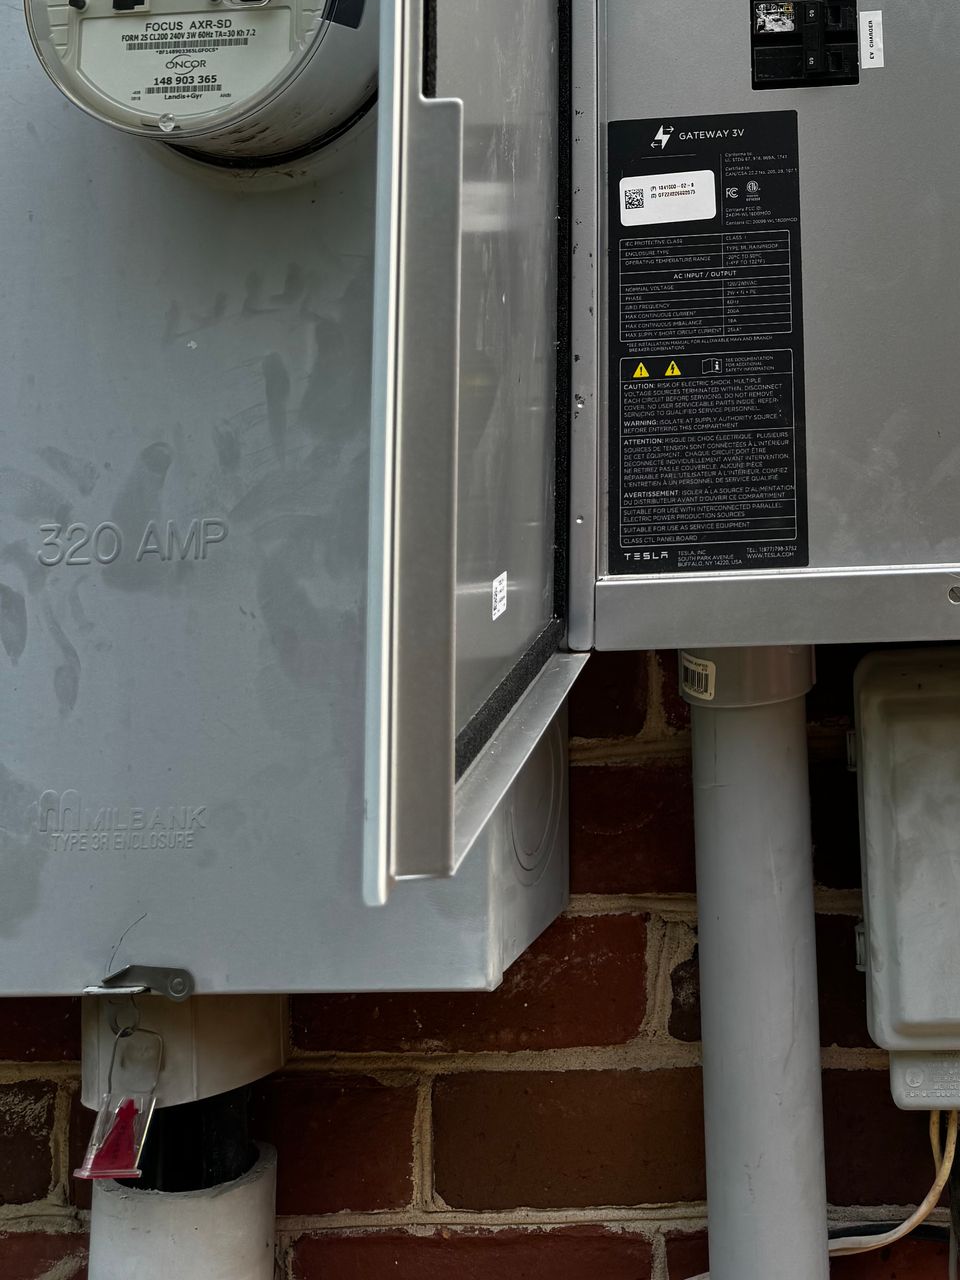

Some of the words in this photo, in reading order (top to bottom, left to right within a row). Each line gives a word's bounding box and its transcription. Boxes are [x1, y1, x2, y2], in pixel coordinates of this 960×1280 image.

[146, 22, 183, 32] FOCUS
[190, 19, 232, 30] AXR-SD
[166, 59, 206, 70] ONCOR
[154, 76, 172, 85] 148
[176, 76, 194, 84] 903
[197, 75, 217, 83] 365
[679, 130, 729, 140] GATEWAY
[38, 522, 122, 566] 320
[136, 518, 229, 562] AMP
[624, 552, 668, 560] TESLA
[86, 807, 206, 832] MILBANK
[51, 834, 88, 851] TYPE
[113, 831, 194, 850] ENCLOSURE
